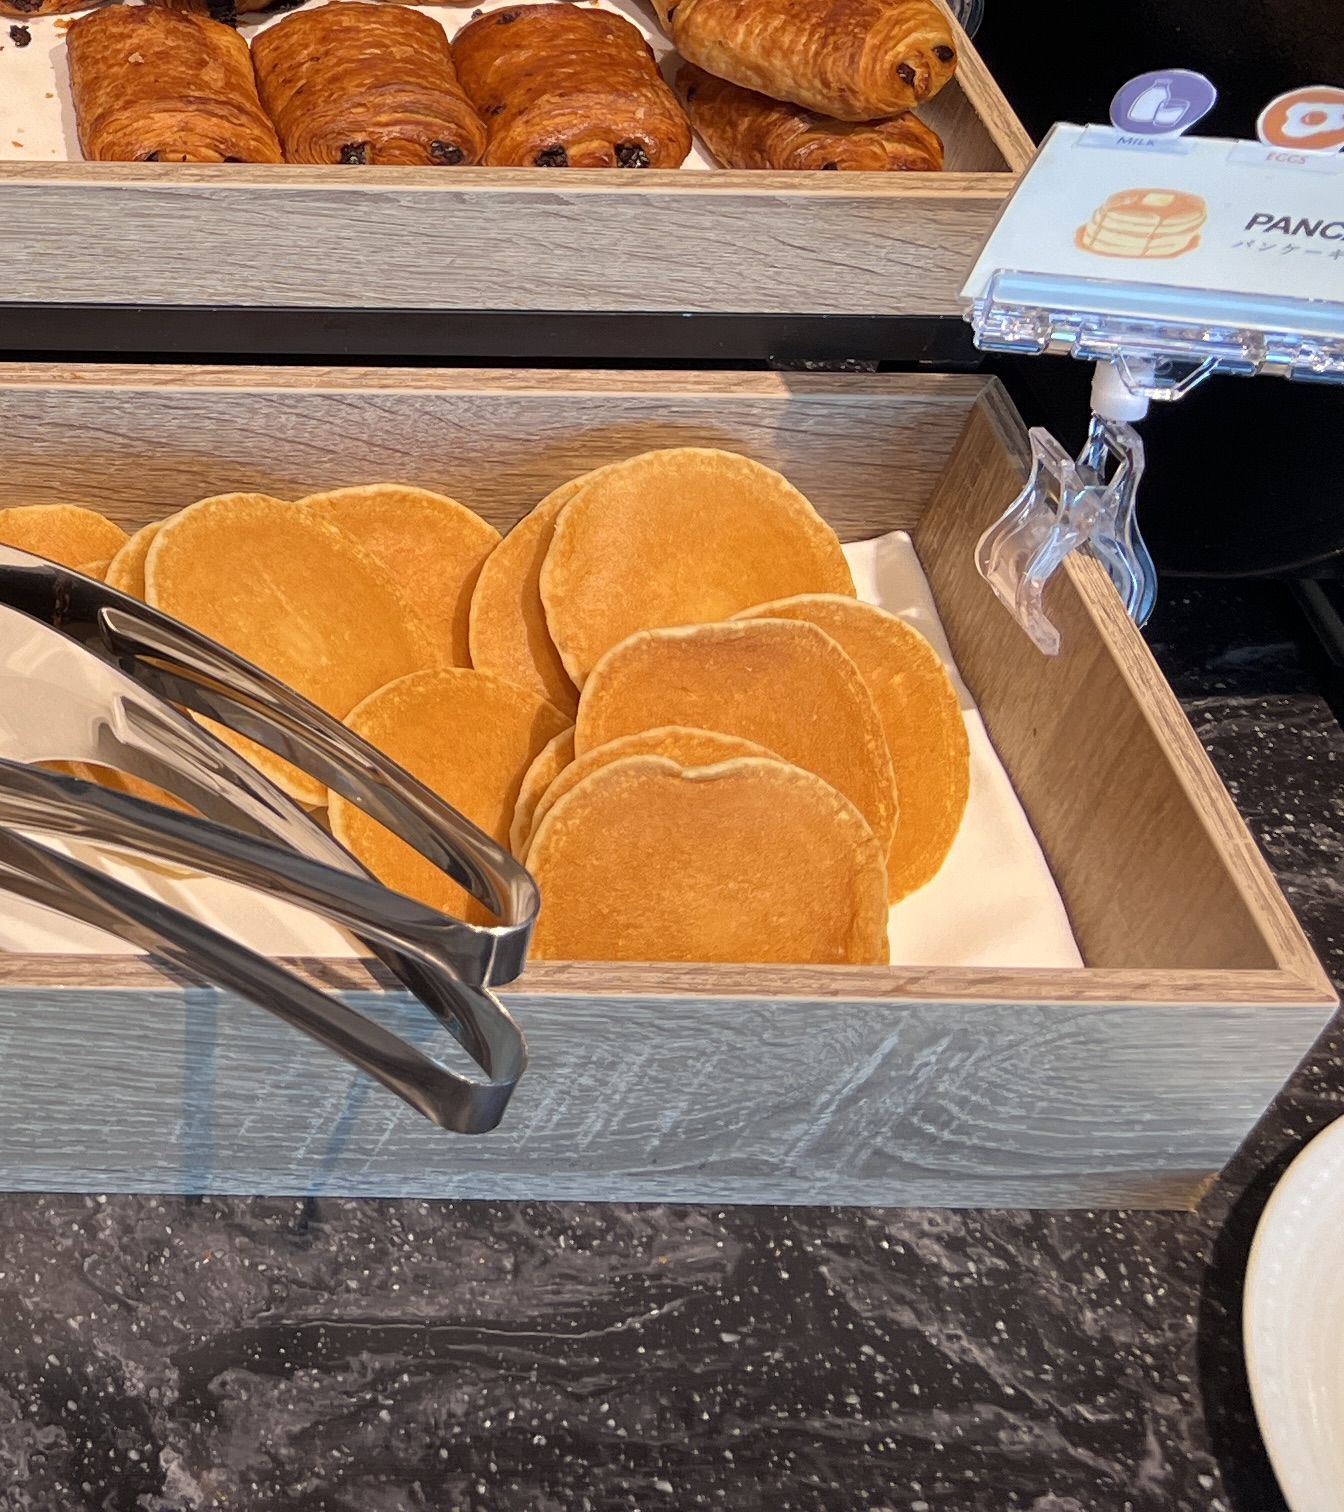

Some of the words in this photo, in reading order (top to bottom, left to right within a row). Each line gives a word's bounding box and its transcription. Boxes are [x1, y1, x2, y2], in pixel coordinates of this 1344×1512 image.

[1115, 136, 1156, 147] MILK
[1265, 152, 1309, 165] EGGS
[1244, 212, 1344, 241] PANC
